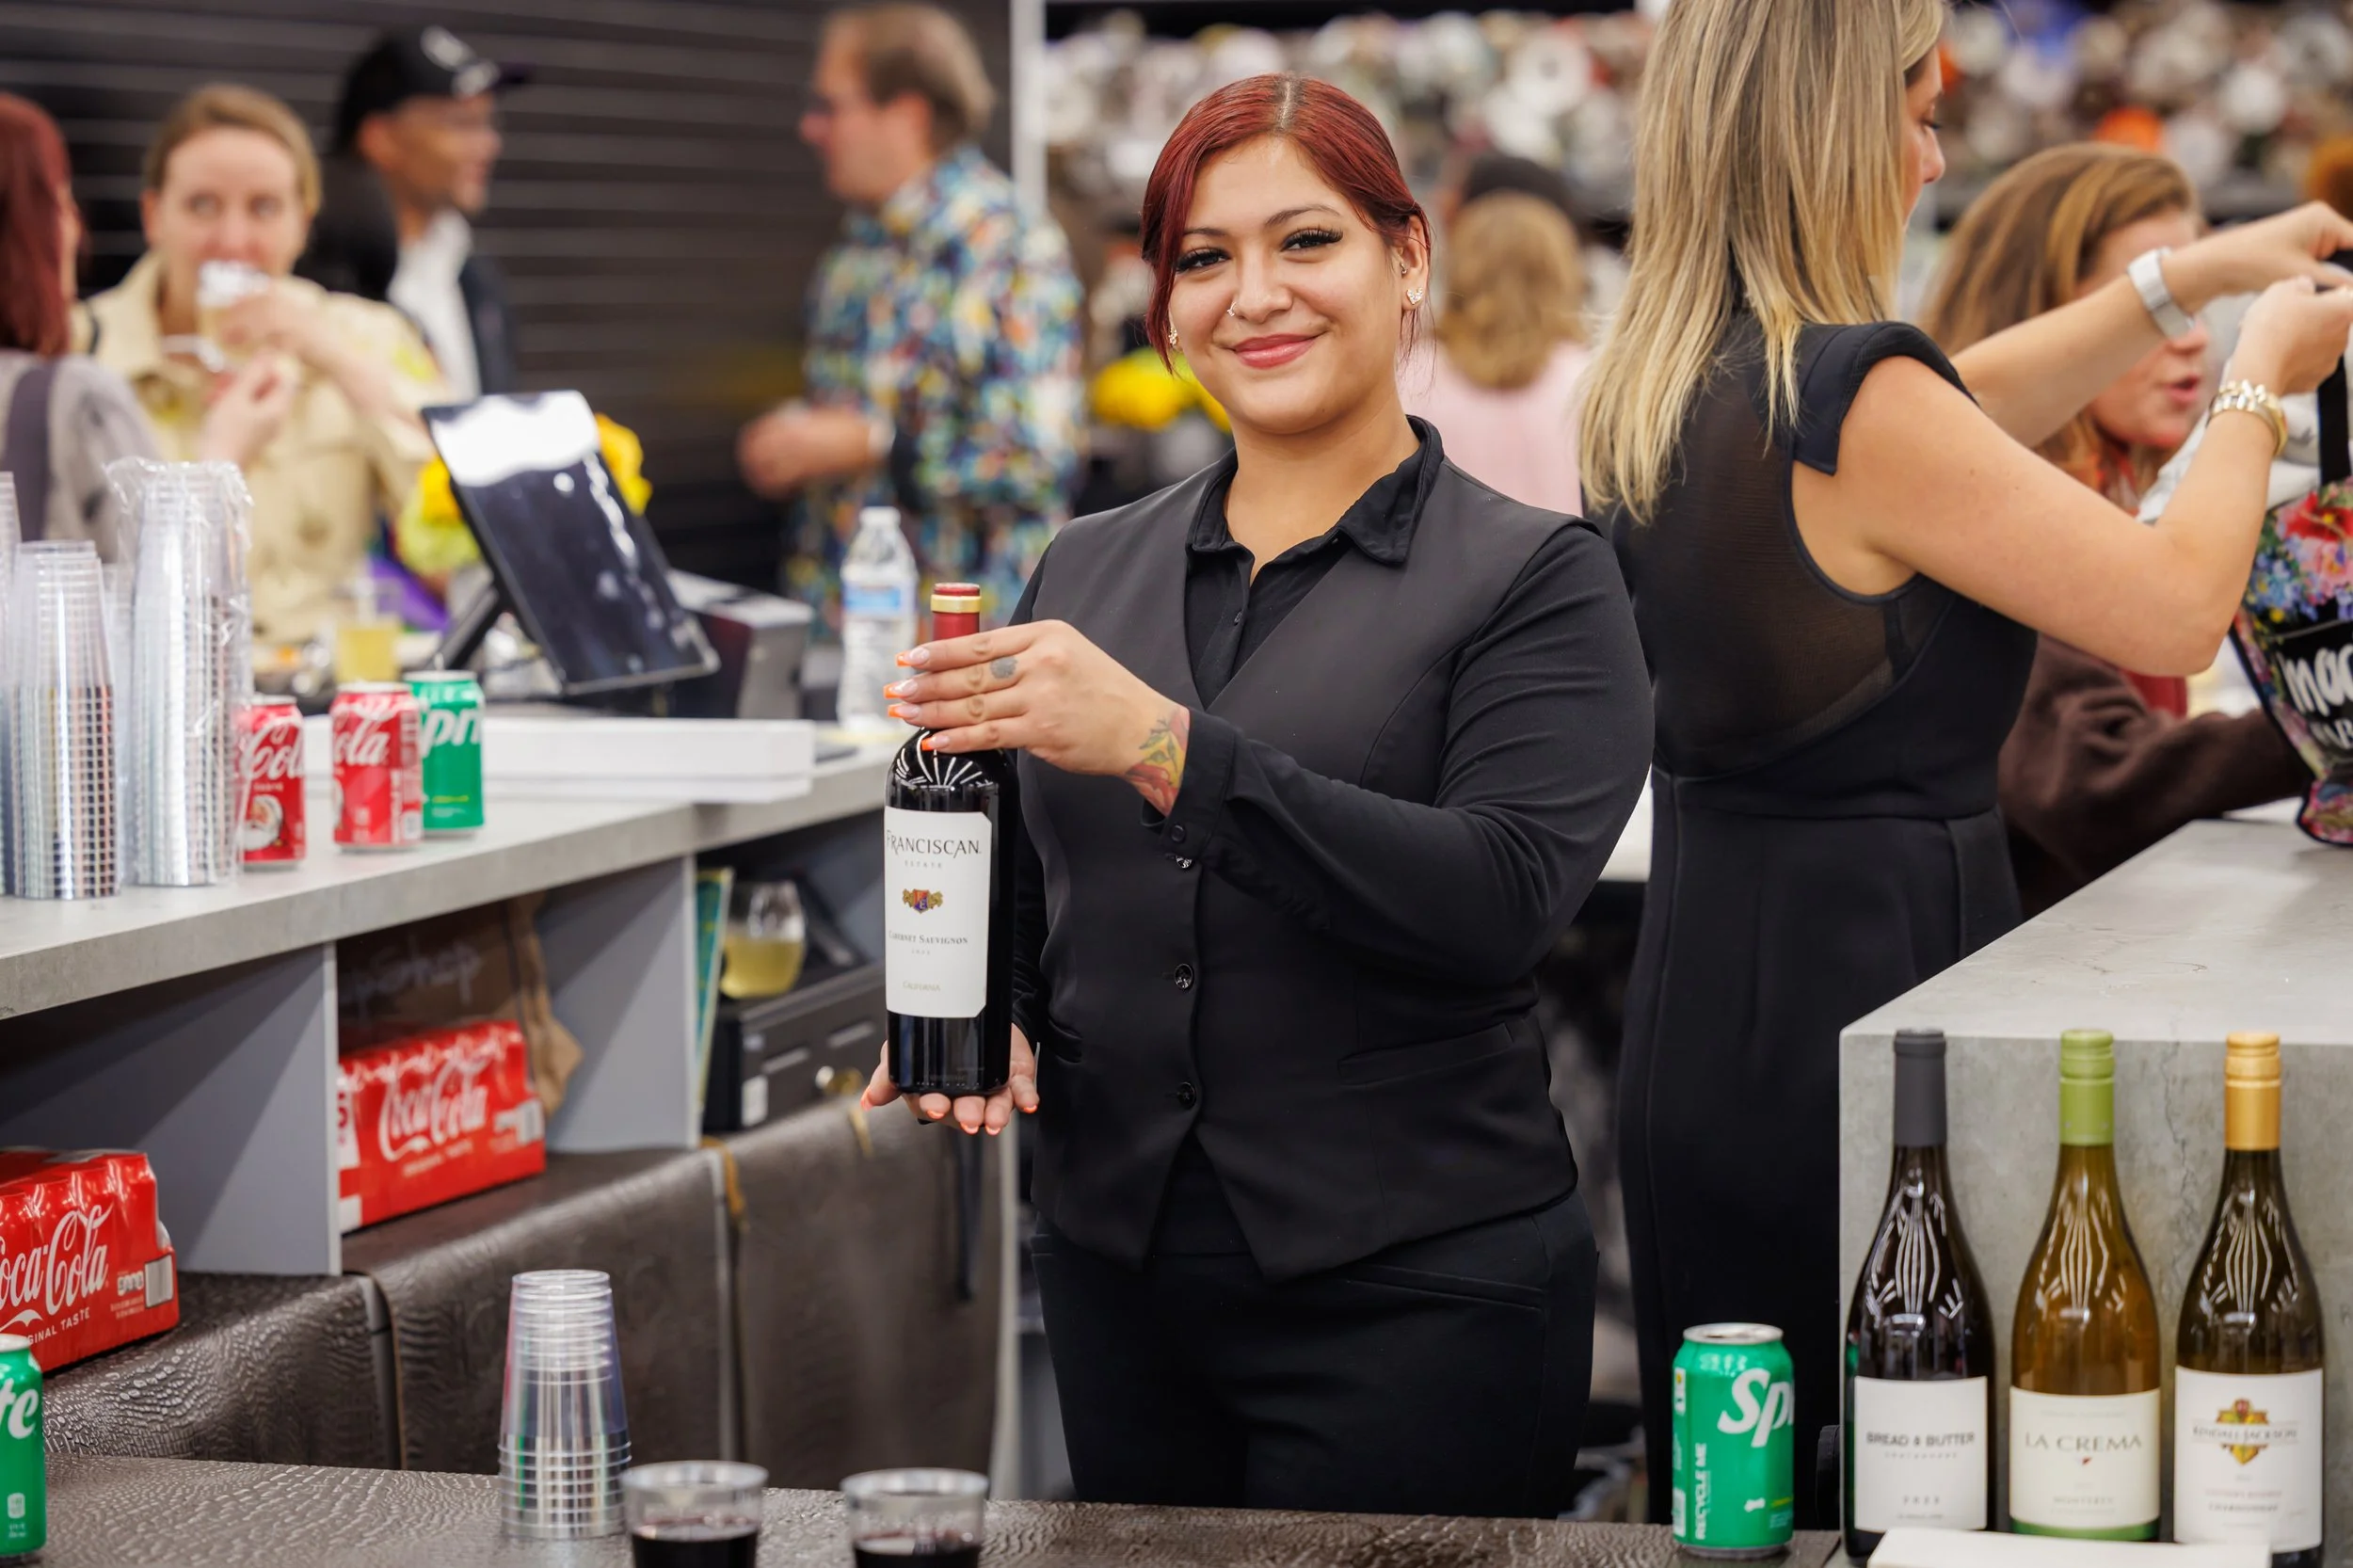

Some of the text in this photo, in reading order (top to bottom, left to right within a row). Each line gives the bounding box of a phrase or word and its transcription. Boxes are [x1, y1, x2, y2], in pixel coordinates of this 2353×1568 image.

[887, 829, 982, 858] FRANCISCAN
[919, 934, 968, 945] SAUVIGNON
[903, 980, 941, 991] CALIFORNIA
[27, 1306, 90, 1345] GINAL TASTE
[1866, 1432, 1910, 1448] BREAD
[1926, 1432, 1976, 1448] BUTTER
[2025, 1432, 2143, 1452] LA CREMA
[1694, 1442, 1707, 1467] ME
